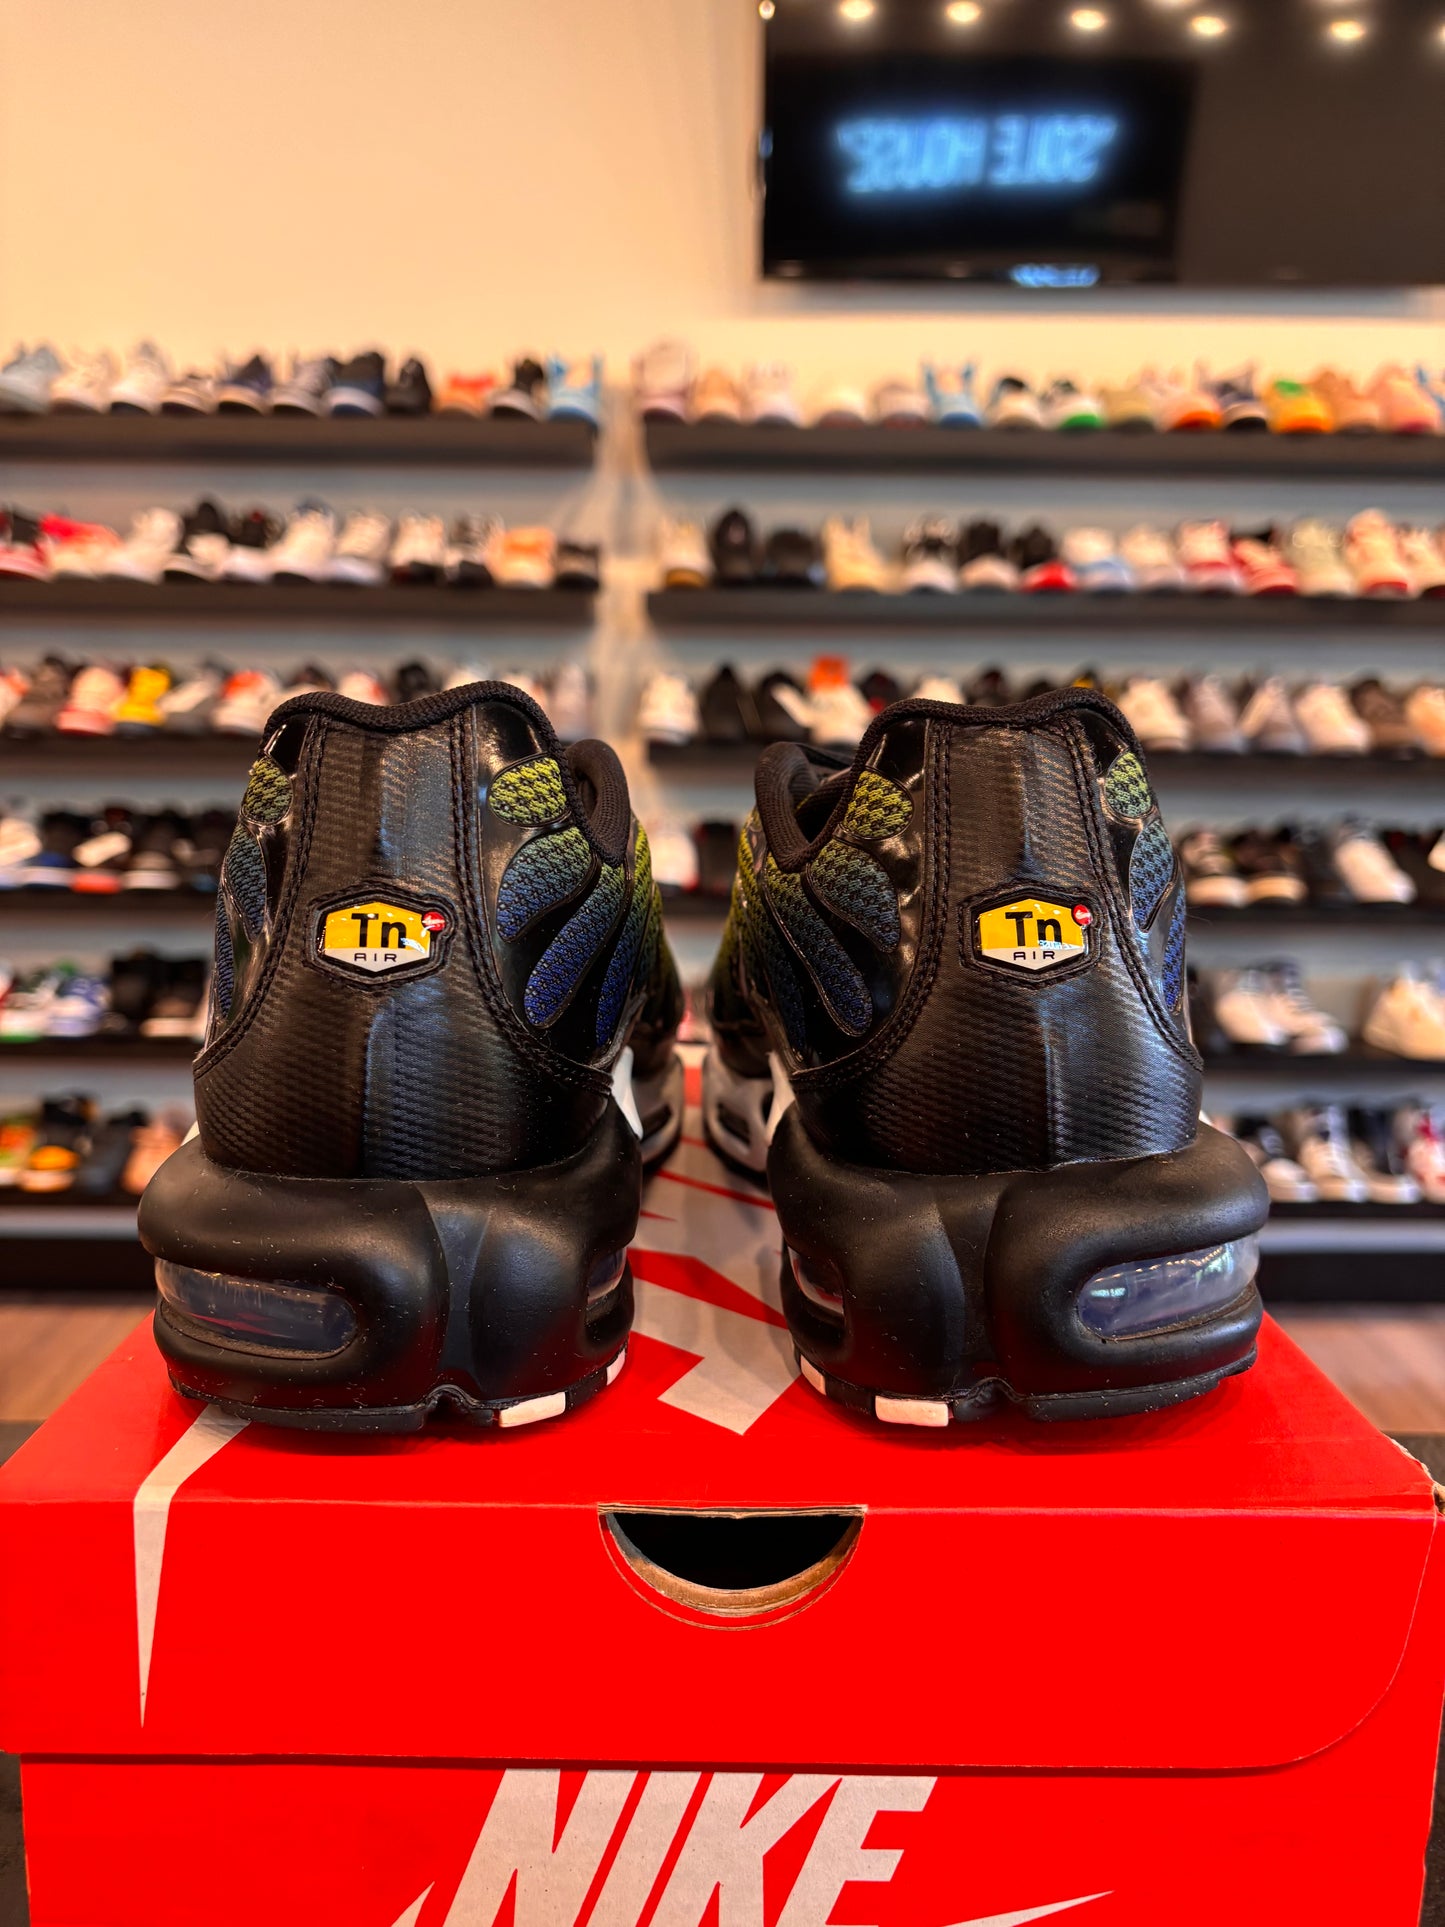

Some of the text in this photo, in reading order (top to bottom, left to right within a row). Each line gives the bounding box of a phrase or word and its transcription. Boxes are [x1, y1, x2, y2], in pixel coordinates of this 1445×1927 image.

[351, 913, 406, 948] Tn
[1005, 911, 1062, 947] Tn
[354, 953, 397, 962] AIR
[1013, 951, 1055, 961] AIR
[442, 1767, 938, 1927] NIKE
